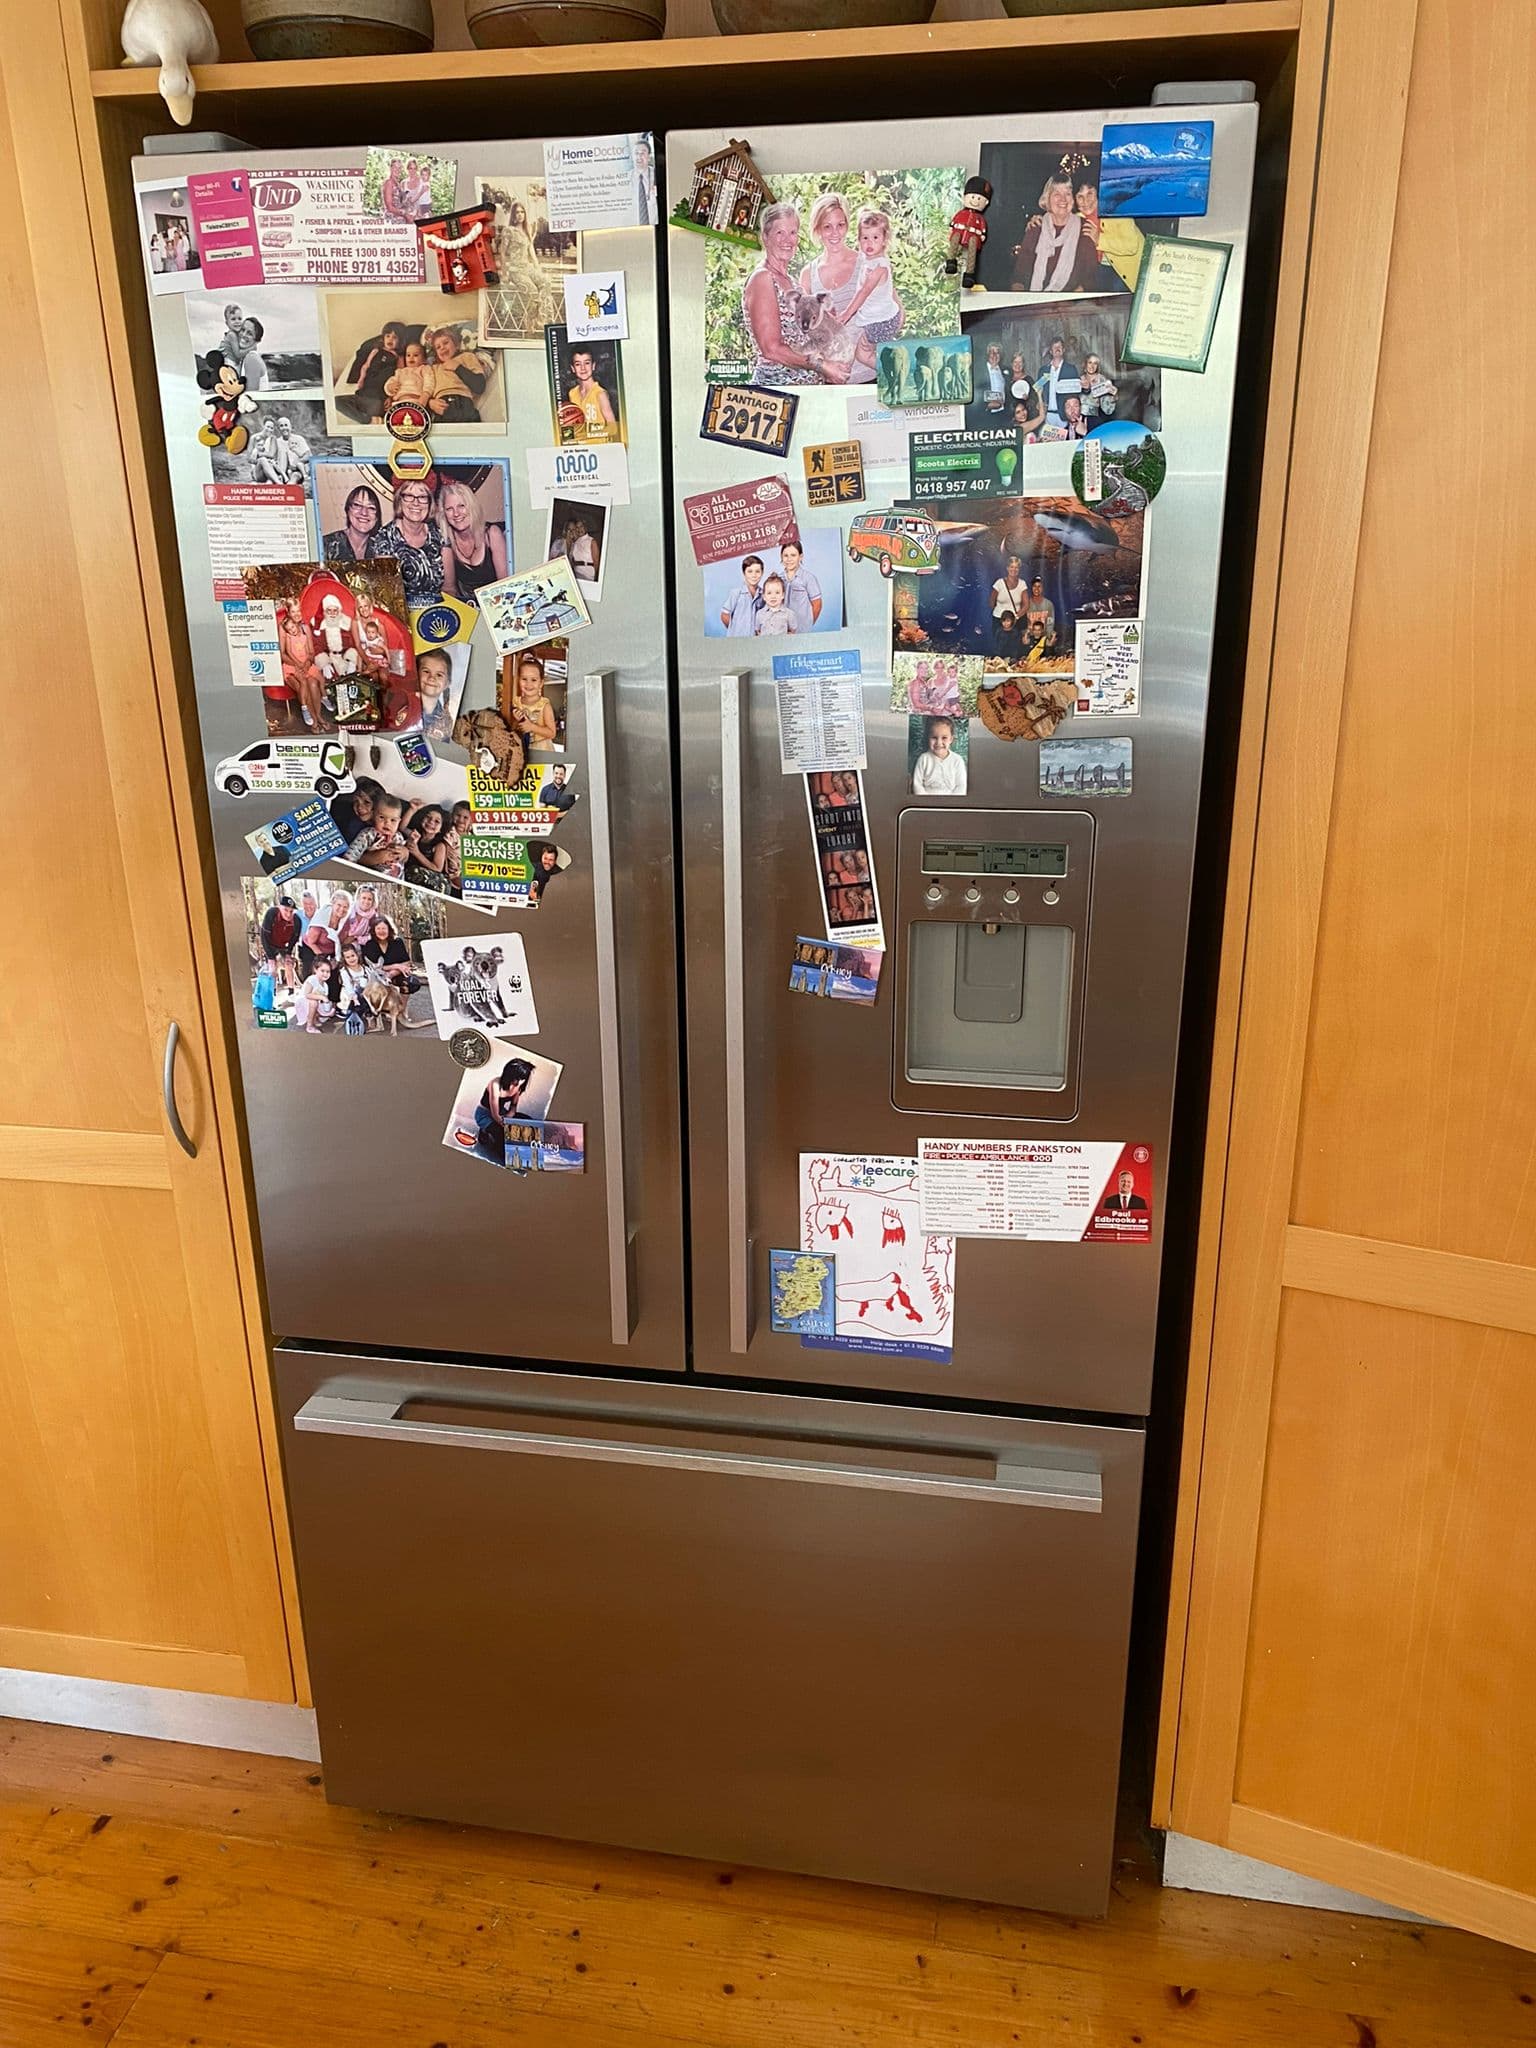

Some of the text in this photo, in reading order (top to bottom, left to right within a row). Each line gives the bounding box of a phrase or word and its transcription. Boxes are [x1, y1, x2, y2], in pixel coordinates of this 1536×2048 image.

[299, 169, 350, 177] EFFICIENT
[306, 180, 354, 190] WASHING
[254, 184, 298, 209] UNIT
[311, 193, 354, 203] SERVICE
[552, 219, 576, 229] HCF
[307, 247, 417, 258] TOLL FREE 1300 891 553
[307, 260, 417, 274] PHONE 9781 4362
[726, 392, 778, 412] SANTIAGO
[904, 405, 950, 417] windows
[719, 405, 777, 440] 2017
[913, 429, 1017, 444] ELECTRICIAN
[917, 459, 945, 468] Scoota
[947, 458, 979, 467] Electrix
[562, 474, 600, 482] ELECTRICAL
[915, 479, 991, 493] 0418 957 407
[710, 493, 730, 506] ALL
[808, 489, 835, 499] BUEN
[712, 498, 747, 514] BRAND
[809, 497, 836, 506] CAMINO
[713, 503, 766, 523] ELECTRICS
[712, 538, 729, 550] (03)
[730, 531, 753, 545] 9781
[753, 524, 777, 539] 2188
[249, 604, 263, 612] and
[227, 613, 274, 622] Emergencies
[261, 642, 279, 650] 2812
[251, 780, 273, 788] 1300
[275, 780, 292, 788] 599
[471, 780, 537, 791] SOLUTONS
[294, 801, 321, 821] SAM'S
[475, 811, 551, 823] 03 9116 9093
[295, 821, 334, 845] Plumber
[462, 838, 525, 852] BLOCKED
[463, 847, 523, 860] DRAINS?
[464, 880, 528, 893] 03 9116 9075
[460, 979, 492, 991] KOALAS
[457, 990, 499, 1004] FOREVER
[924, 1142, 1082, 1154] HANDY NUMBERS FRANKSTON
[980, 1154, 1030, 1162] AMBULANCE
[862, 1165, 916, 1178] leecare
[1094, 1216, 1137, 1224] Edbrooke
